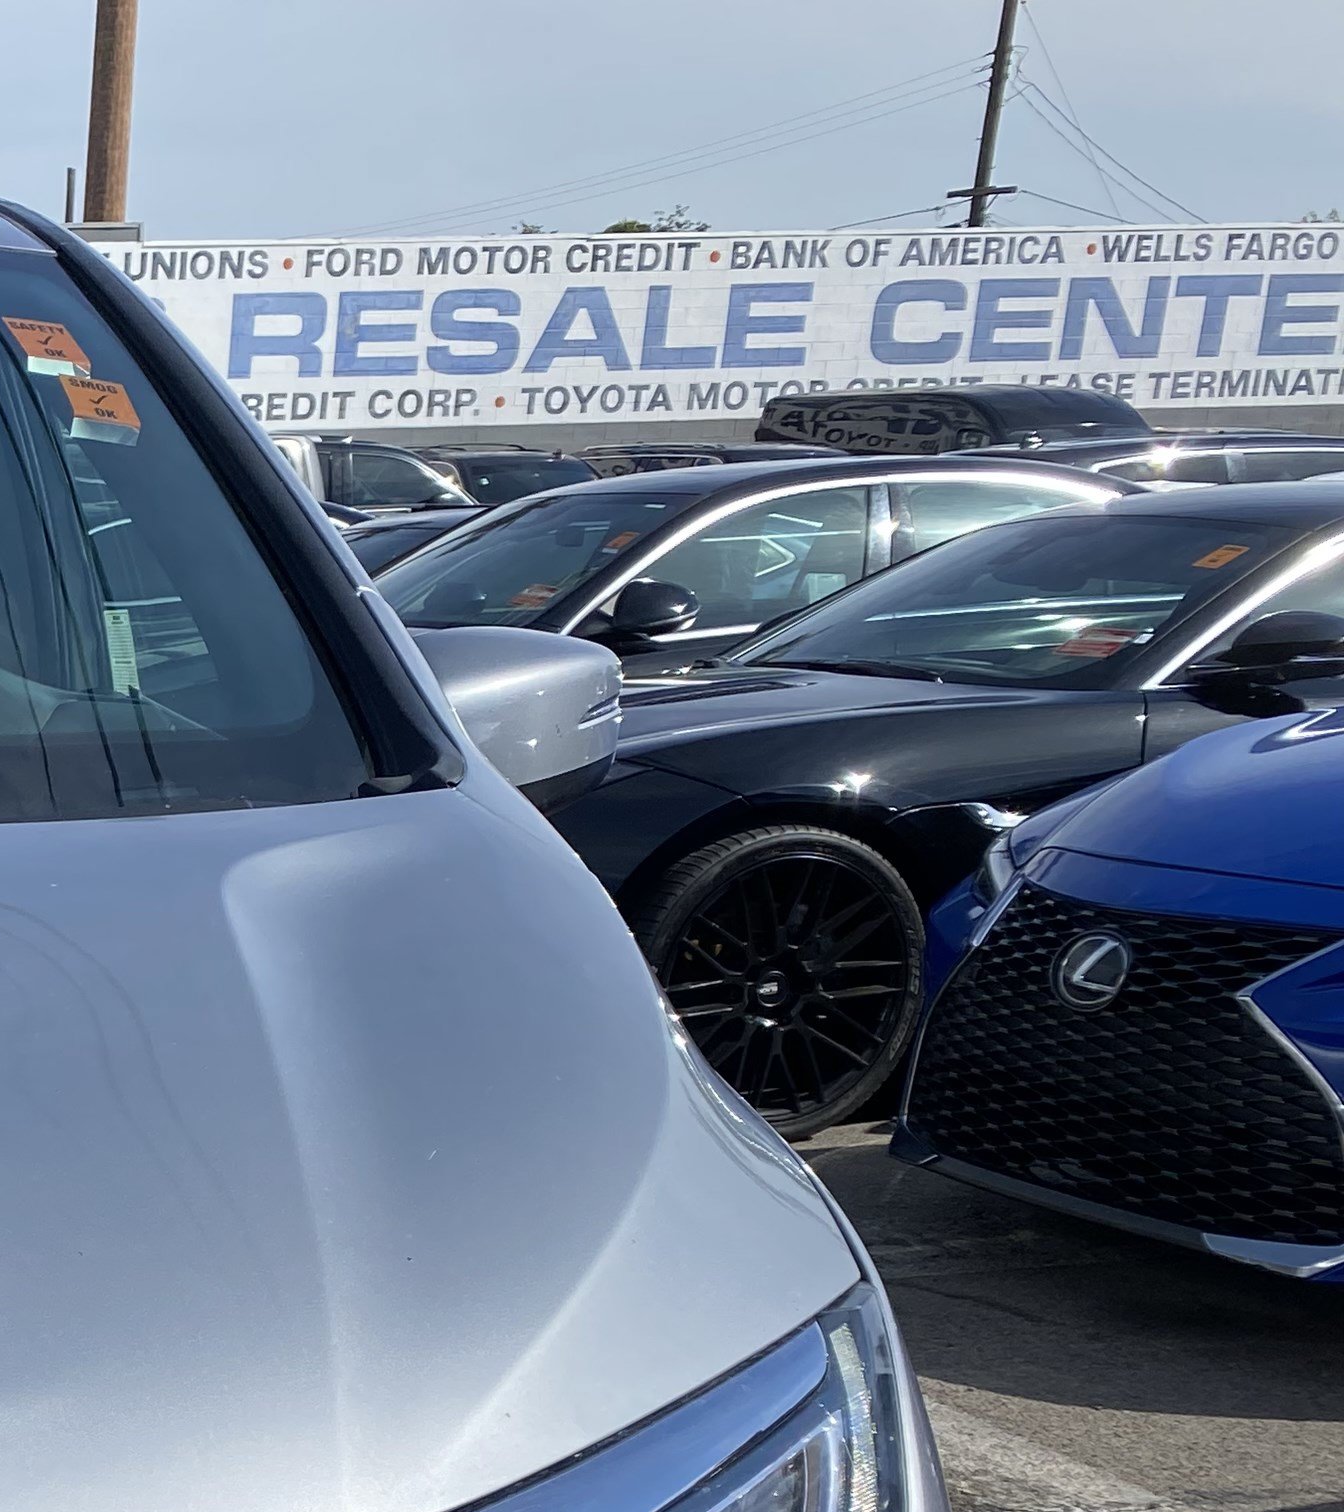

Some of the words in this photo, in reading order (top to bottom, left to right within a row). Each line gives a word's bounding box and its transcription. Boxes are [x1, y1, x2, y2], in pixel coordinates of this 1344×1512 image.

[124, 249, 269, 281] UNIONS
[304, 247, 403, 278] FORD
[417, 244, 552, 276] MOTOR
[565, 241, 701, 273] CREDIT
[730, 239, 831, 269] BANK
[845, 238, 892, 268] OF
[898, 234, 1064, 267] AMERICA
[1101, 232, 1214, 264] WELLS
[1224, 231, 1339, 262] FARGO
[8, 320, 66, 336] SAFETY
[227, 281, 815, 379] RESALE
[870, 273, 1344, 365] CENTE
[45, 348, 67, 359] OK
[68, 377, 118, 395] SMOG
[368, 387, 480, 421] CORP.
[520, 383, 673, 415] TOYOTA
[95, 407, 118, 420] OK
